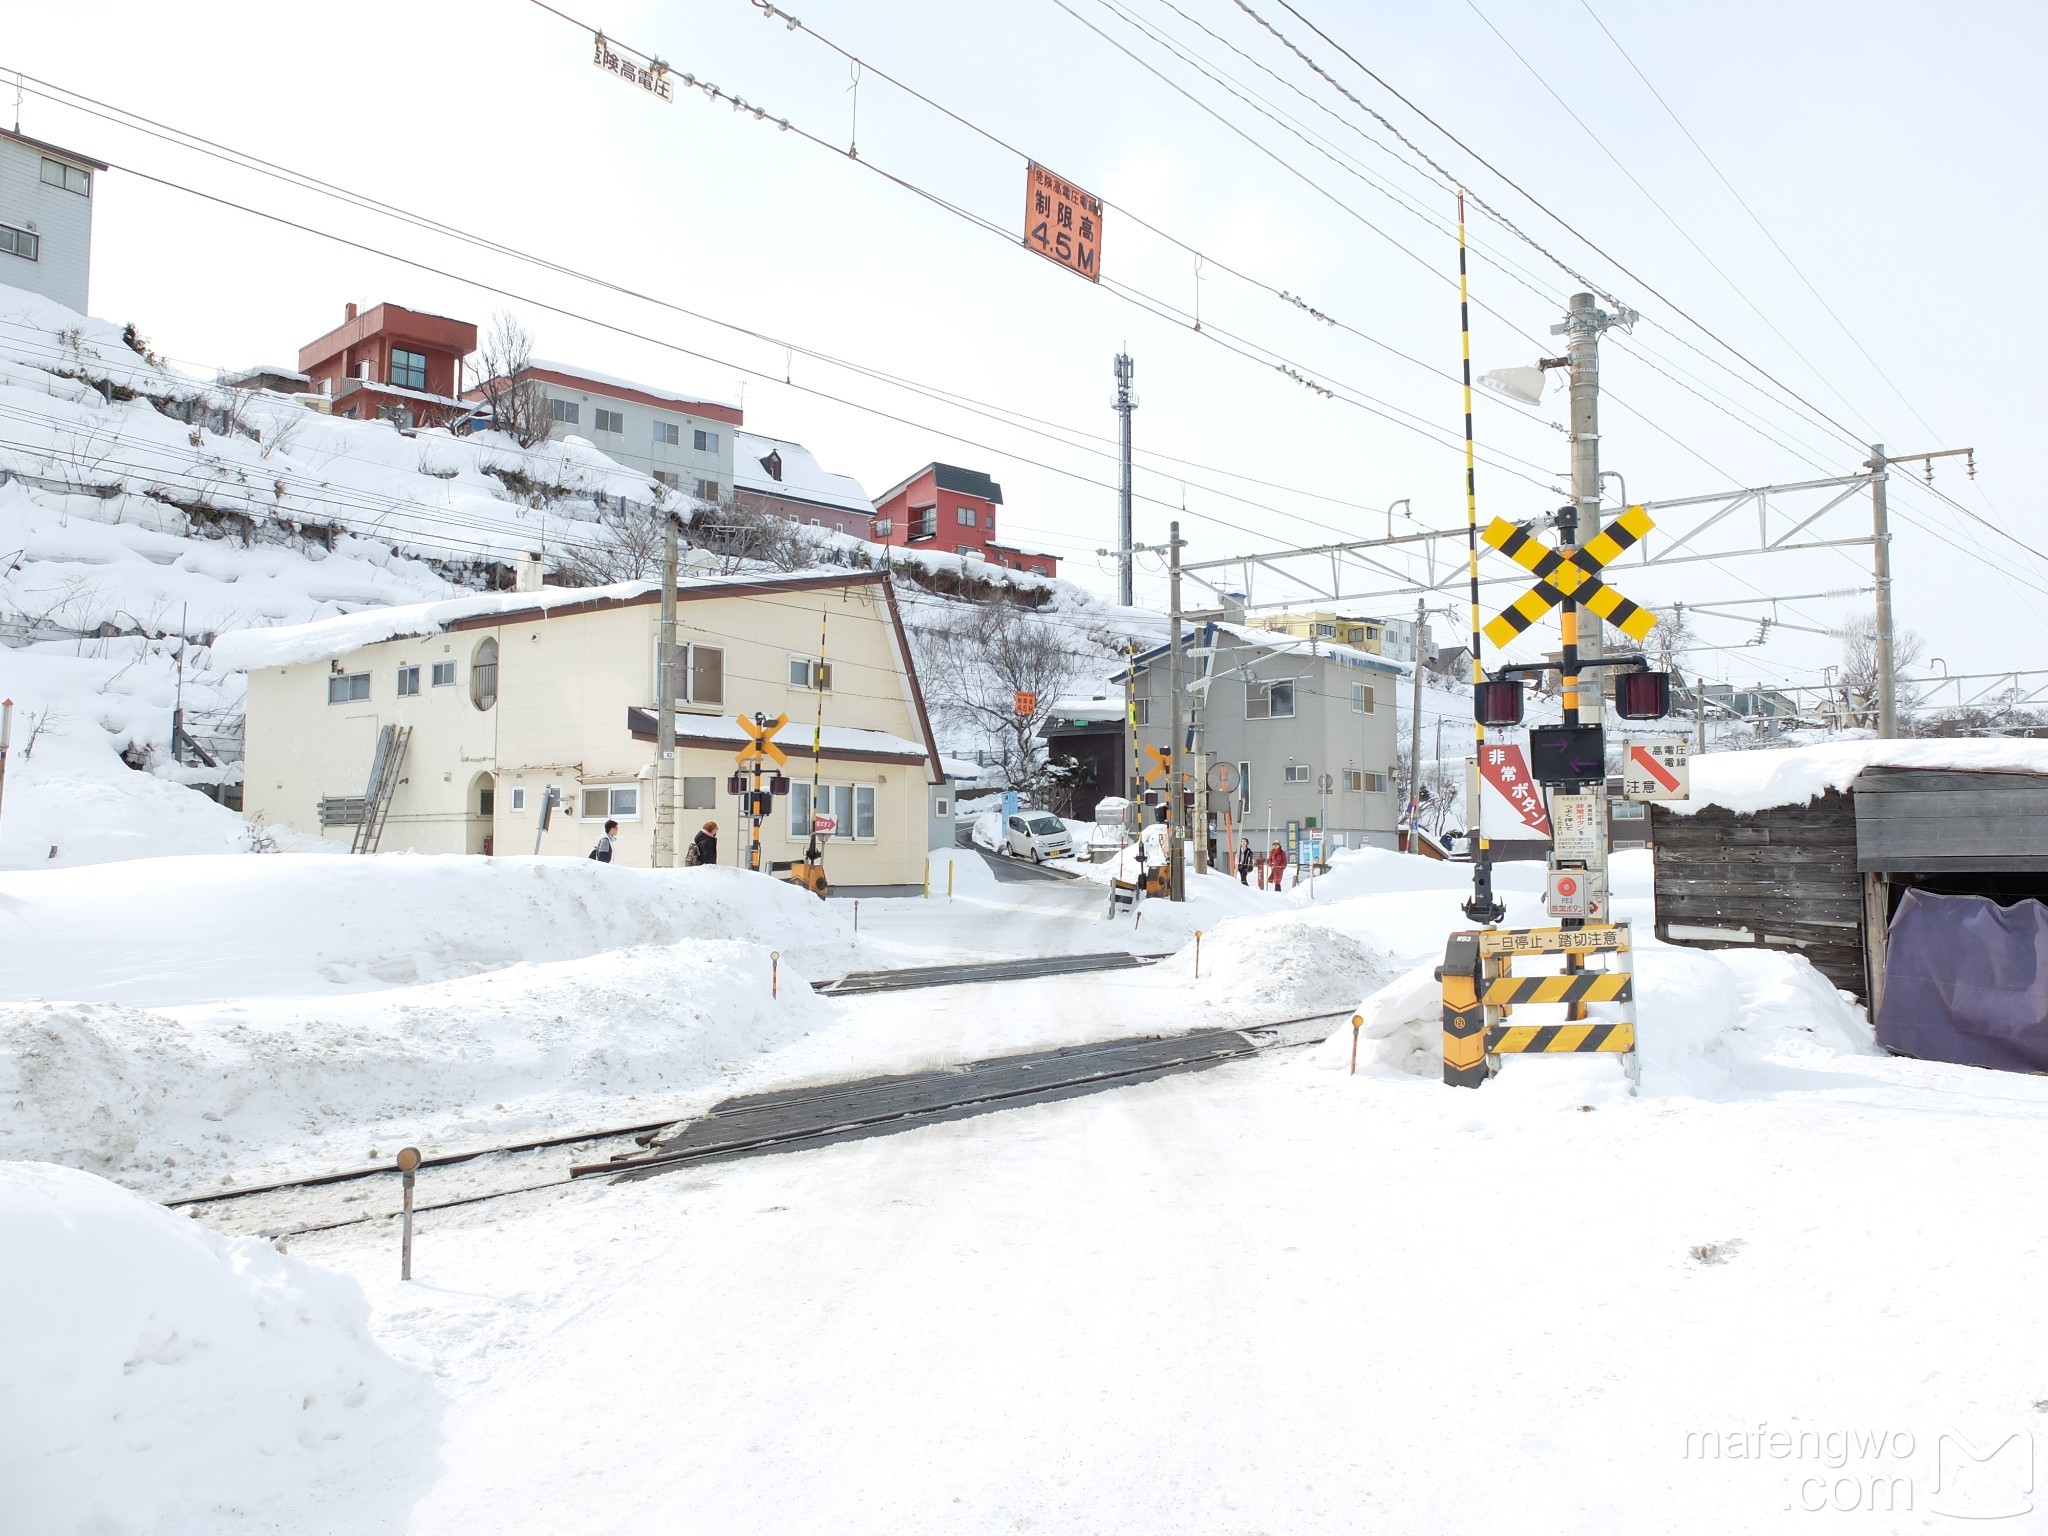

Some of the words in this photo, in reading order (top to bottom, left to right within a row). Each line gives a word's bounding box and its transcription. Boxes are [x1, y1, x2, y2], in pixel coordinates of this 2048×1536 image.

[1035, 189, 1094, 243] 制限高
[1652, 745, 1687, 756] 高電圧
[1664, 757, 1687, 768] 電線
[1488, 748, 1547, 826] 非常ボタン
[1626, 780, 1657, 794] 注意
[1551, 905, 1584, 913] 非常ボタン
[1487, 931, 1617, 950] 一旦停止・踏切注意
